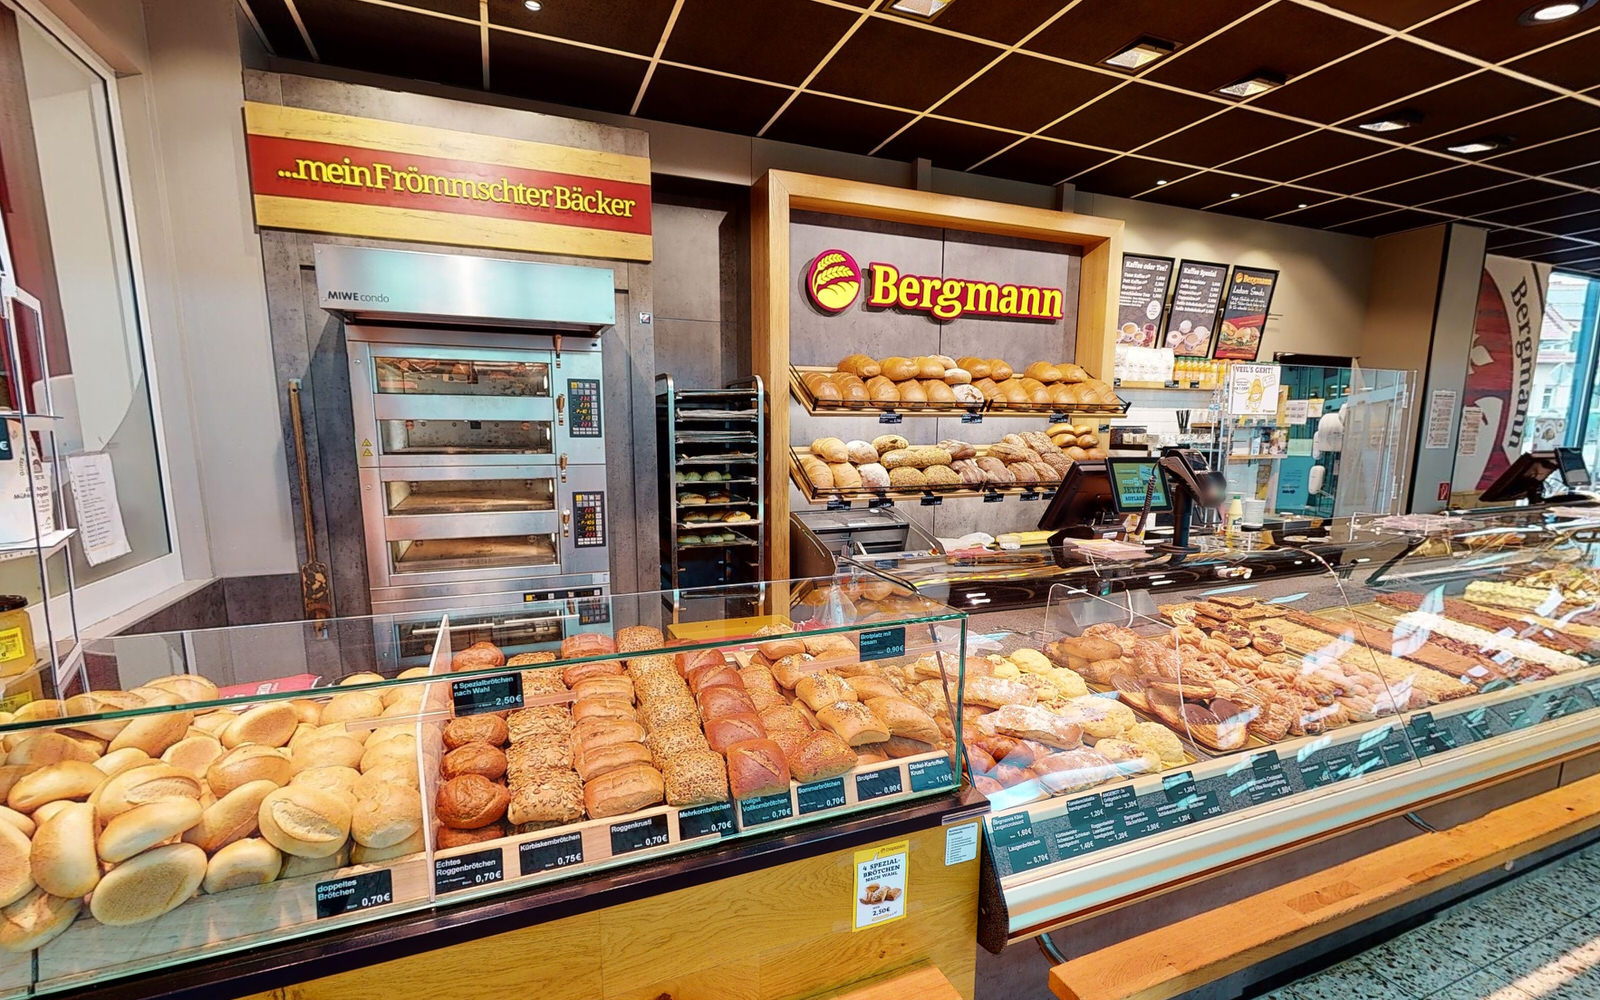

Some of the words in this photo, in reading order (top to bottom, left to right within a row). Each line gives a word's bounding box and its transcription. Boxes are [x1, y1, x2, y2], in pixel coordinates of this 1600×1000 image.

[373, 164, 553, 208] Frömmschter
[553, 186, 636, 218] Bäcker
[1126, 261, 1143, 270] Kaffee
[1143, 263, 1156, 271] oder
[1243, 275, 1272, 286] Bergmann
[328, 291, 359, 301] MIWE
[360, 294, 390, 303] condo
[870, 262, 1064, 319] Bergmann
[1509, 276, 1532, 449] Bergmann
[459, 676, 514, 689] Spezialbrötchen
[454, 688, 472, 697] nach
[472, 686, 490, 695] Wahl
[857, 773, 879, 782] Brotplatz
[679, 803, 731, 818] Mehrkornbrötchen
[742, 798, 788, 812] Vollkornbrötchen
[520, 834, 580, 851] Kürbiskernbrötchen
[1008, 840, 1040, 852] Laugenbrötchen
[436, 858, 461, 869] Echtes
[436, 859, 496, 877] Roggenbrötchen
[870, 858, 901, 871] SPEZIAL-
[865, 875, 881, 883] NACH
[317, 879, 357, 893] doppeltes
[317, 888, 355, 901] Brötchen
